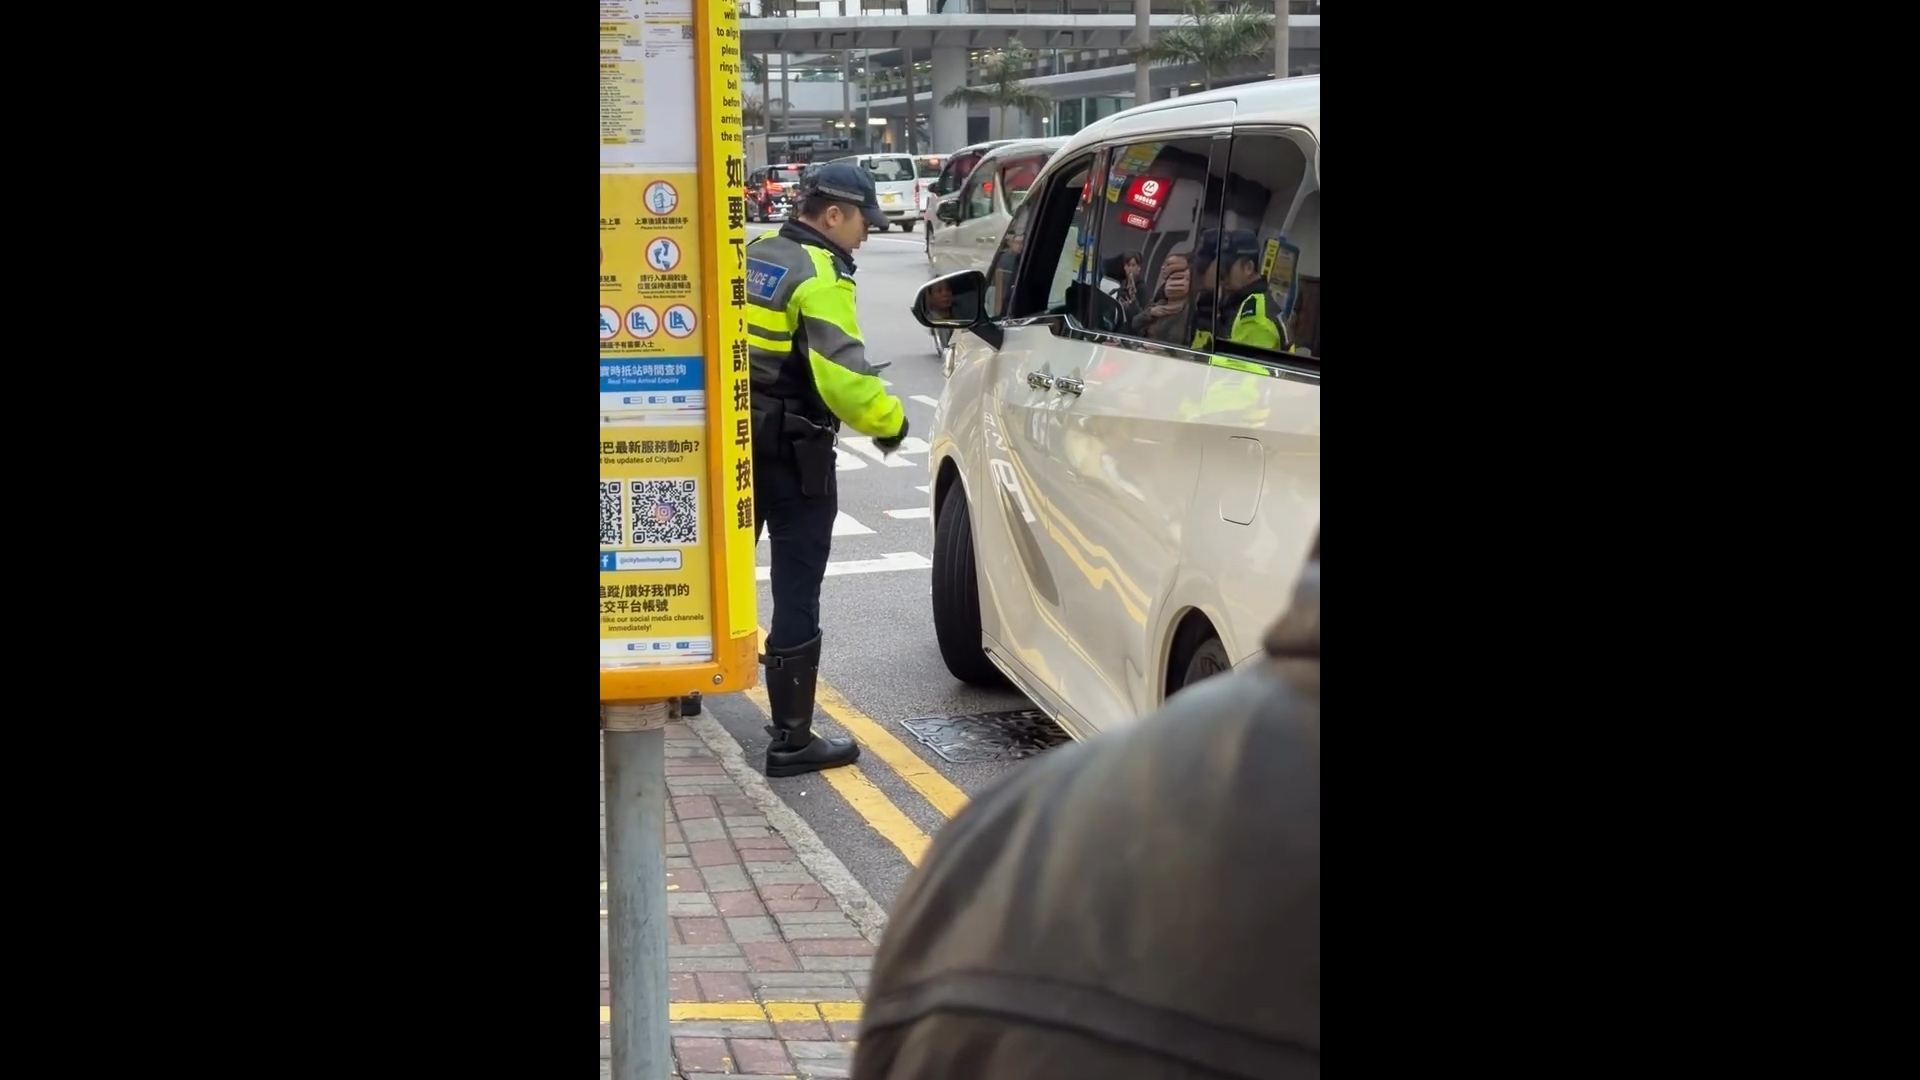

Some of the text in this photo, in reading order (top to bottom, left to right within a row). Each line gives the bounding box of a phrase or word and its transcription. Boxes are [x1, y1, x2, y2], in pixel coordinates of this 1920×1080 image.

[716, 27, 725, 37] to
[719, 62, 733, 74] ring
[721, 131, 732, 142] the
[747, 269, 768, 286] OLICE
[657, 377, 680, 386] Enquiry
[600, 440, 700, 454] 巴最新服務動向?
[617, 457, 644, 465] updates
[645, 456, 653, 464] of
[654, 456, 684, 465] Citybus?
[600, 599, 669, 613] 交平台帳號
[651, 614, 673, 622] media
[673, 613, 704, 622] channels
[608, 624, 652, 632] immediately!
